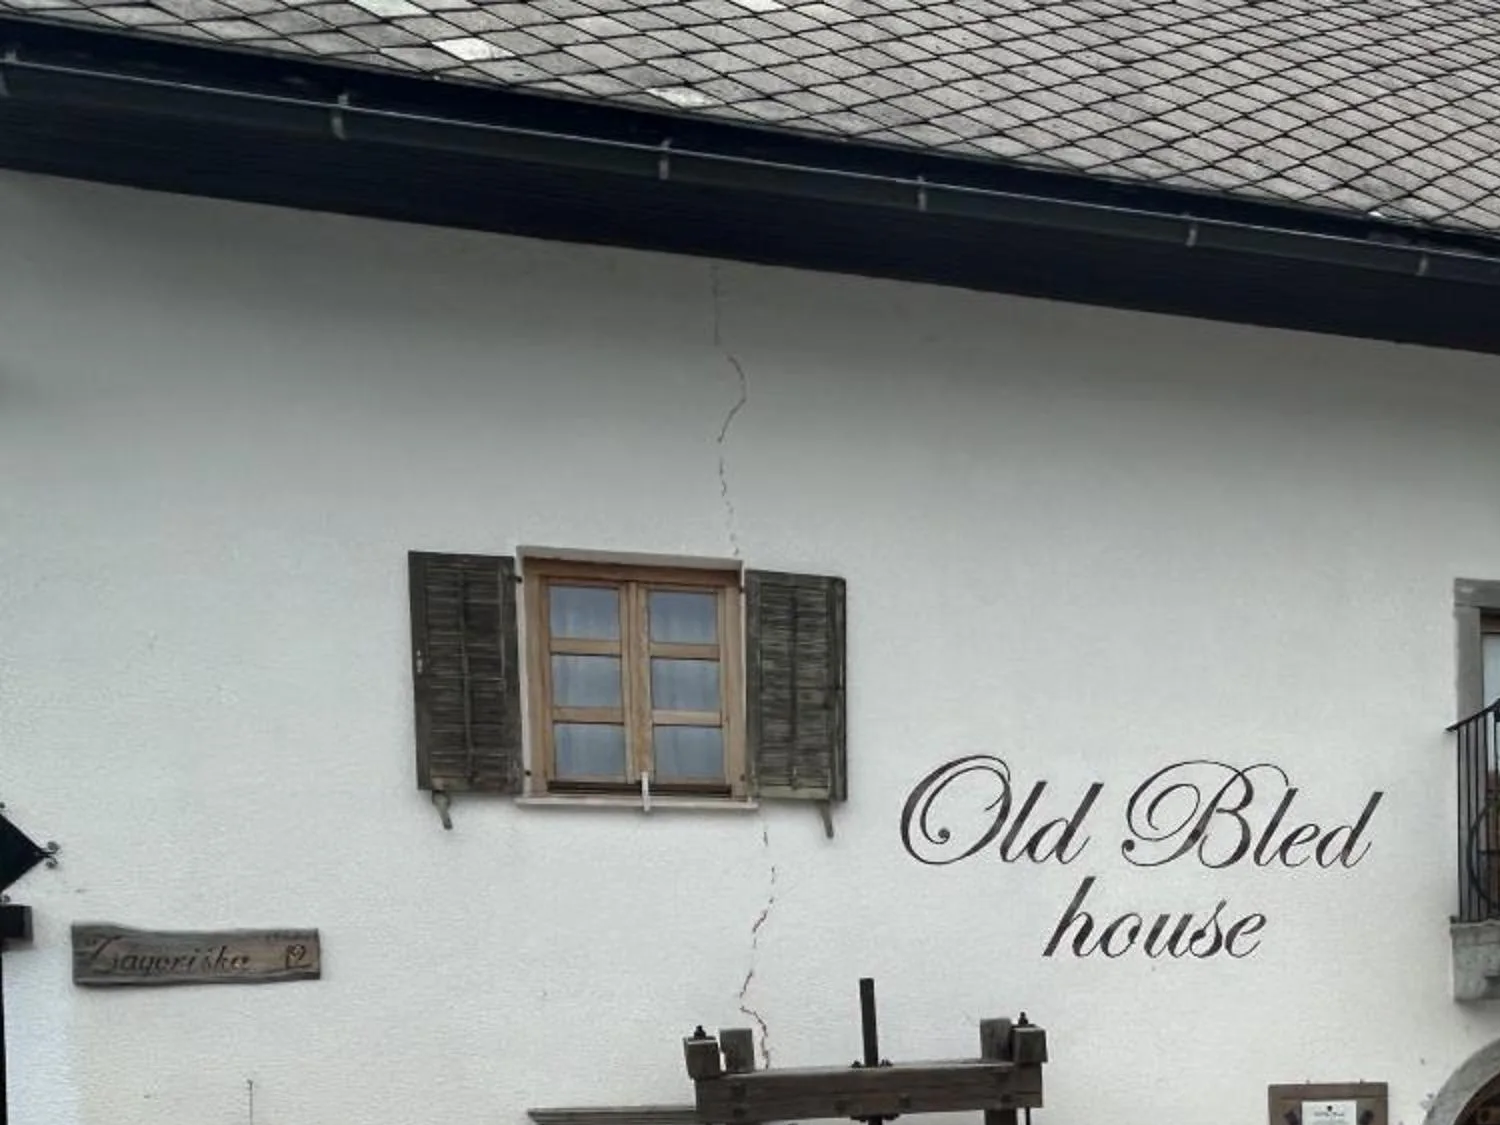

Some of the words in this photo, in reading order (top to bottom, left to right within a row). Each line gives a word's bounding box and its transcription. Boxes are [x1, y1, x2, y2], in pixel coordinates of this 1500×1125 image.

[899, 754, 1104, 866] Old
[1120, 759, 1385, 869] Bled
[1042, 875, 1267, 959] house
